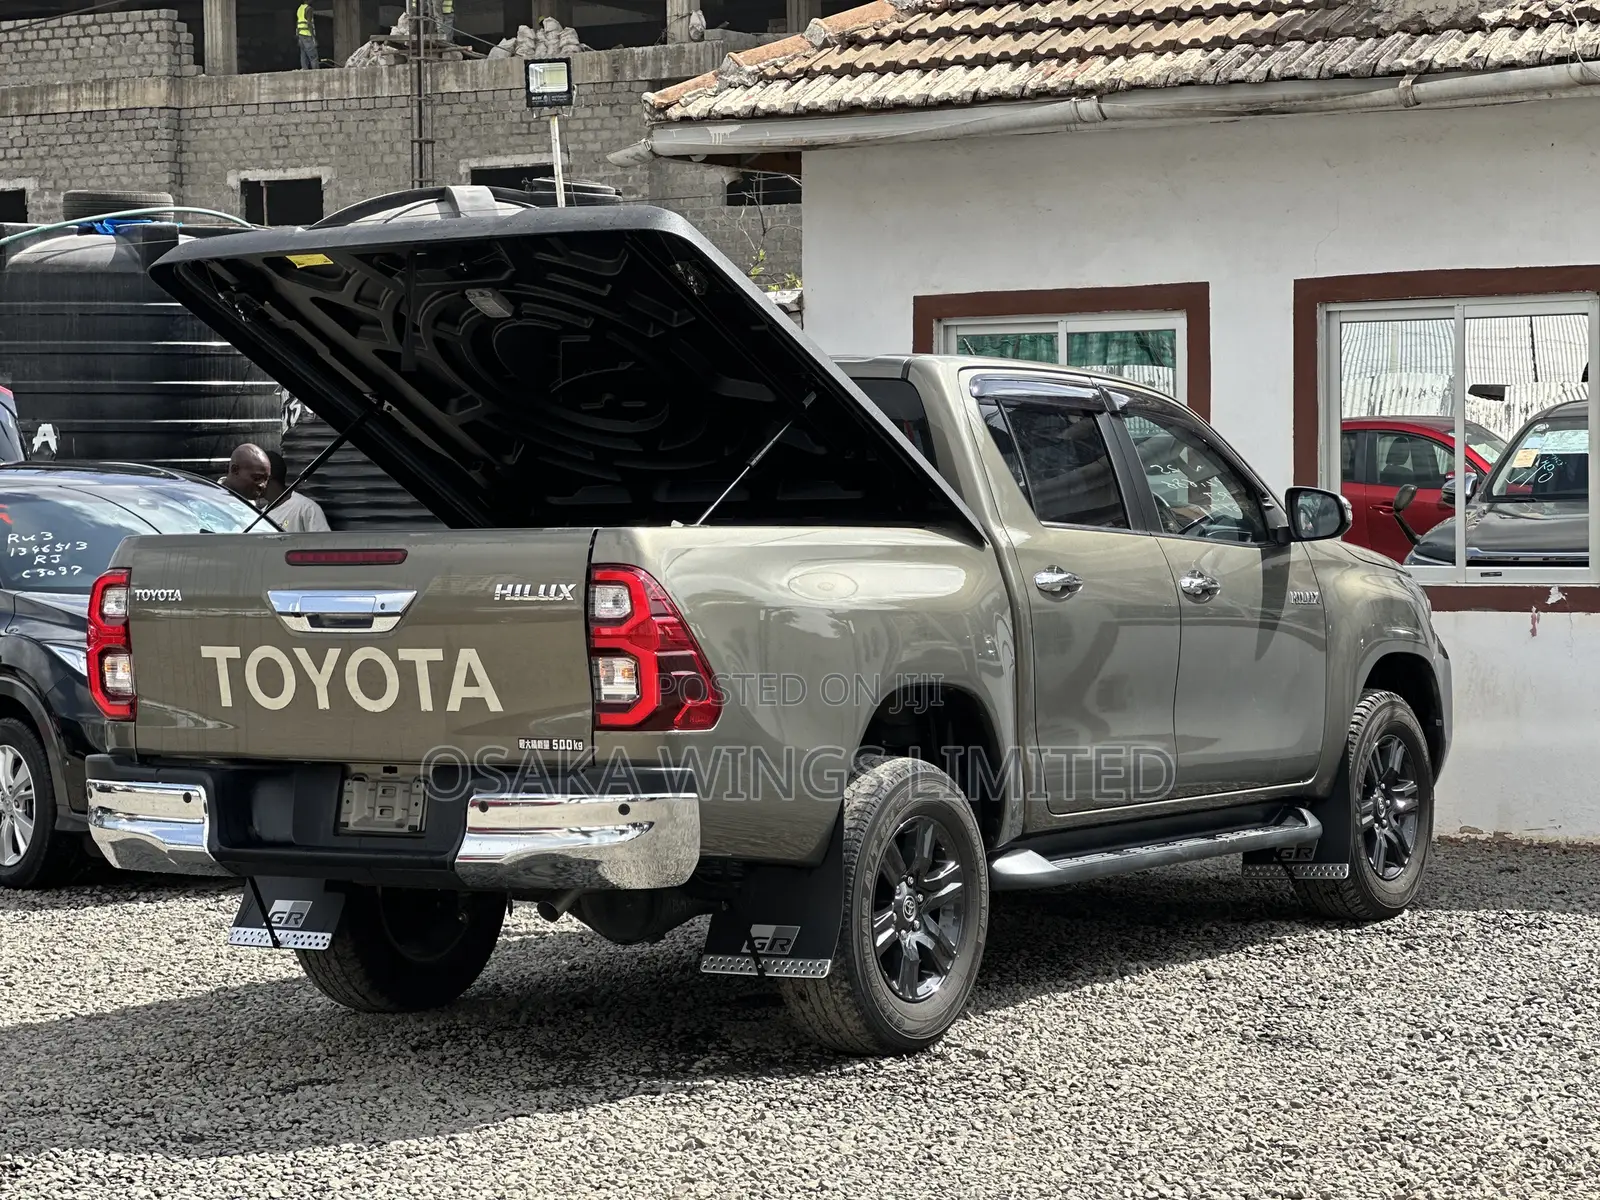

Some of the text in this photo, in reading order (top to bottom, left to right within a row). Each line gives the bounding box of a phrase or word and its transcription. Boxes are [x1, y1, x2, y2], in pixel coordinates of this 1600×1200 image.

[32, 423, 58, 454] A
[134, 589, 182, 601] TOYOTA
[493, 583, 577, 601] HILUX
[200, 645, 504, 713] TOYOTA
[269, 911, 305, 925] GR
[749, 936, 792, 952] GR
